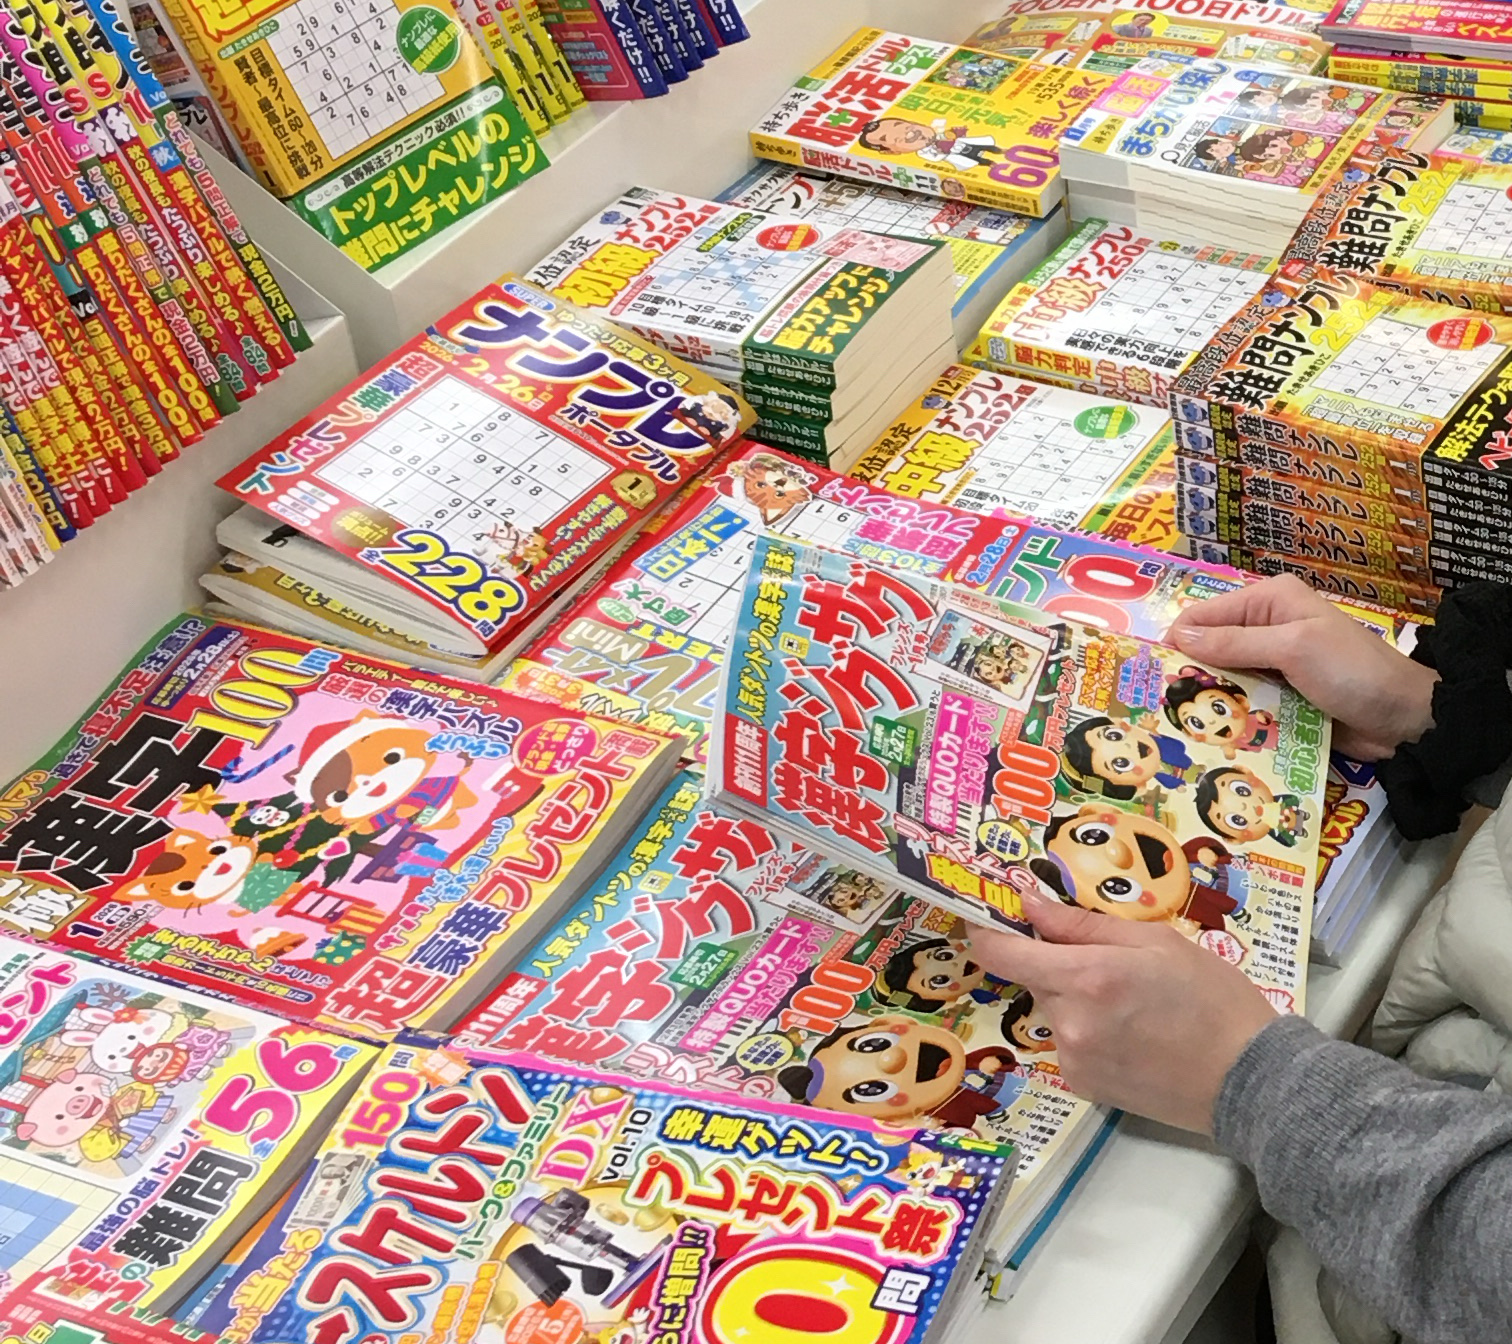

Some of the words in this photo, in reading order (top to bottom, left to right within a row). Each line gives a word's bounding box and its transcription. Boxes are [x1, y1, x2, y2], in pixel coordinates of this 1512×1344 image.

[341, 106, 467, 190] 高等解法テクニック必須!!
[759, 92, 811, 133] 持ち歩き
[1119, 63, 1229, 157] まちがい探し
[329, 114, 510, 232] トップレベルの
[1316, 151, 1430, 274] 難問ナンプレ
[615, 195, 687, 244] ナンプレ
[1067, 226, 1134, 279] ナンプレ
[507, 286, 550, 310] SUPER
[553, 242, 662, 308] 初級
[774, 265, 876, 347] 脳力アップに
[809, 279, 888, 353] チャレンジ
[456, 301, 708, 451] ナンプレ
[1014, 344, 1092, 377] 脳力判定
[1095, 358, 1150, 392] 中級
[1209, 275, 1361, 411] 難問ナンプレ
[237, 354, 442, 493] 超豪華プレゼント
[560, 401, 679, 483] ポータブル
[935, 375, 1004, 433] ナンプレ
[882, 431, 982, 500] 中級
[568, 623, 642, 659] Mini
[186, 648, 342, 750] 100問
[770, 564, 938, 854] 漢字ジグザグ
[0, 712, 223, 893] 漢字
[928, 698, 972, 832] 特製QUOカード
[991, 741, 1060, 824] 100
[687, 919, 803, 1046] 特製QUOカード
[782, 961, 877, 1034] 100
[535, 1091, 632, 1186] DX
[601, 1108, 655, 1182] vol.10
[663, 1106, 884, 1171] 幸運ゲット!
[307, 1074, 530, 1322] スケルトン
[638, 1152, 947, 1256] プレゼント祭
